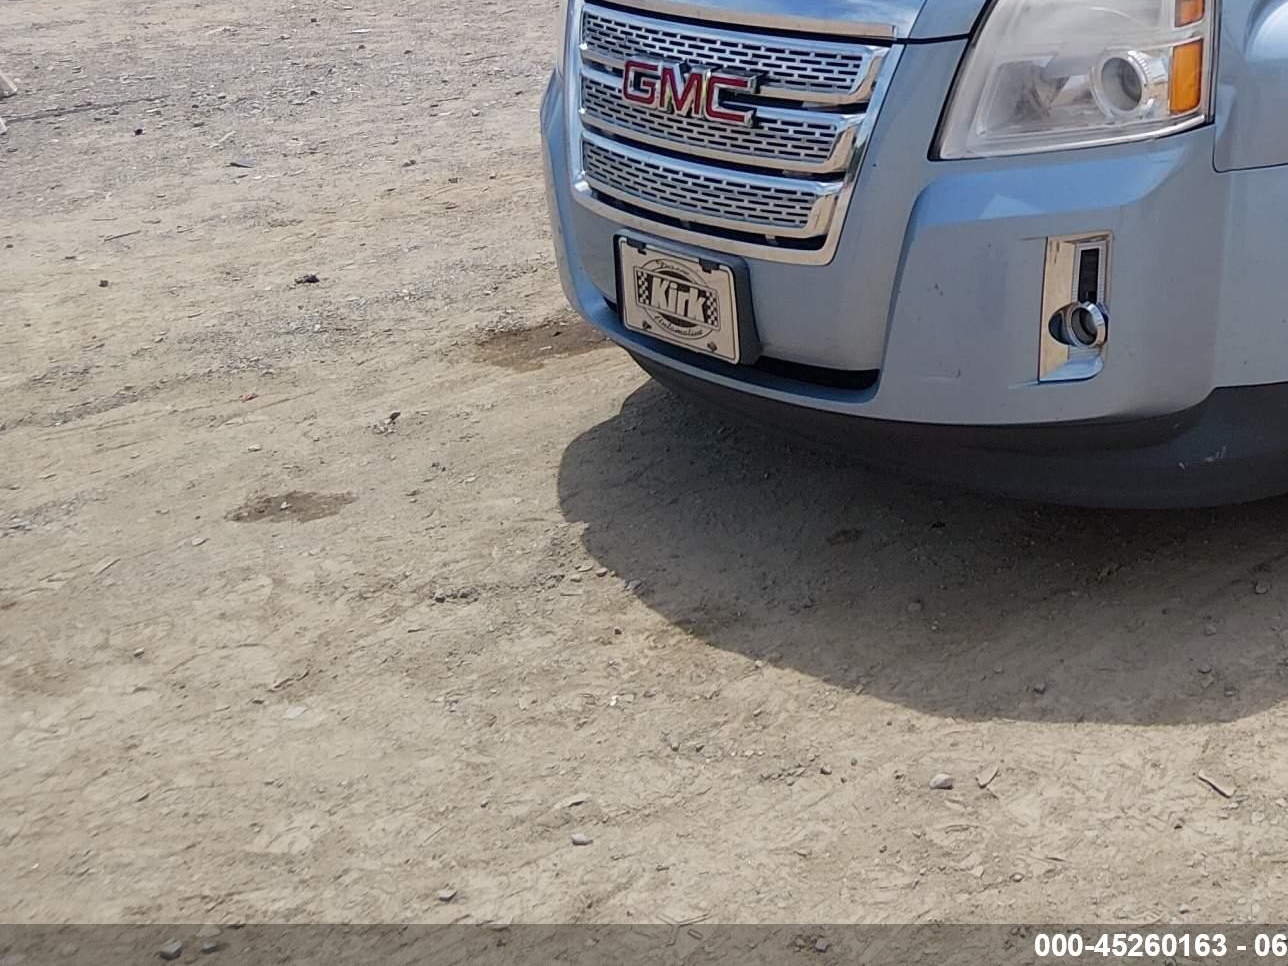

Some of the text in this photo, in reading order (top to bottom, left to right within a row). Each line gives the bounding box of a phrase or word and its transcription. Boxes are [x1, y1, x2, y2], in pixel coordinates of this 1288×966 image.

[623, 57, 758, 127] GMC
[651, 275, 706, 324] Kirk
[654, 314, 703, 337] Automotive
